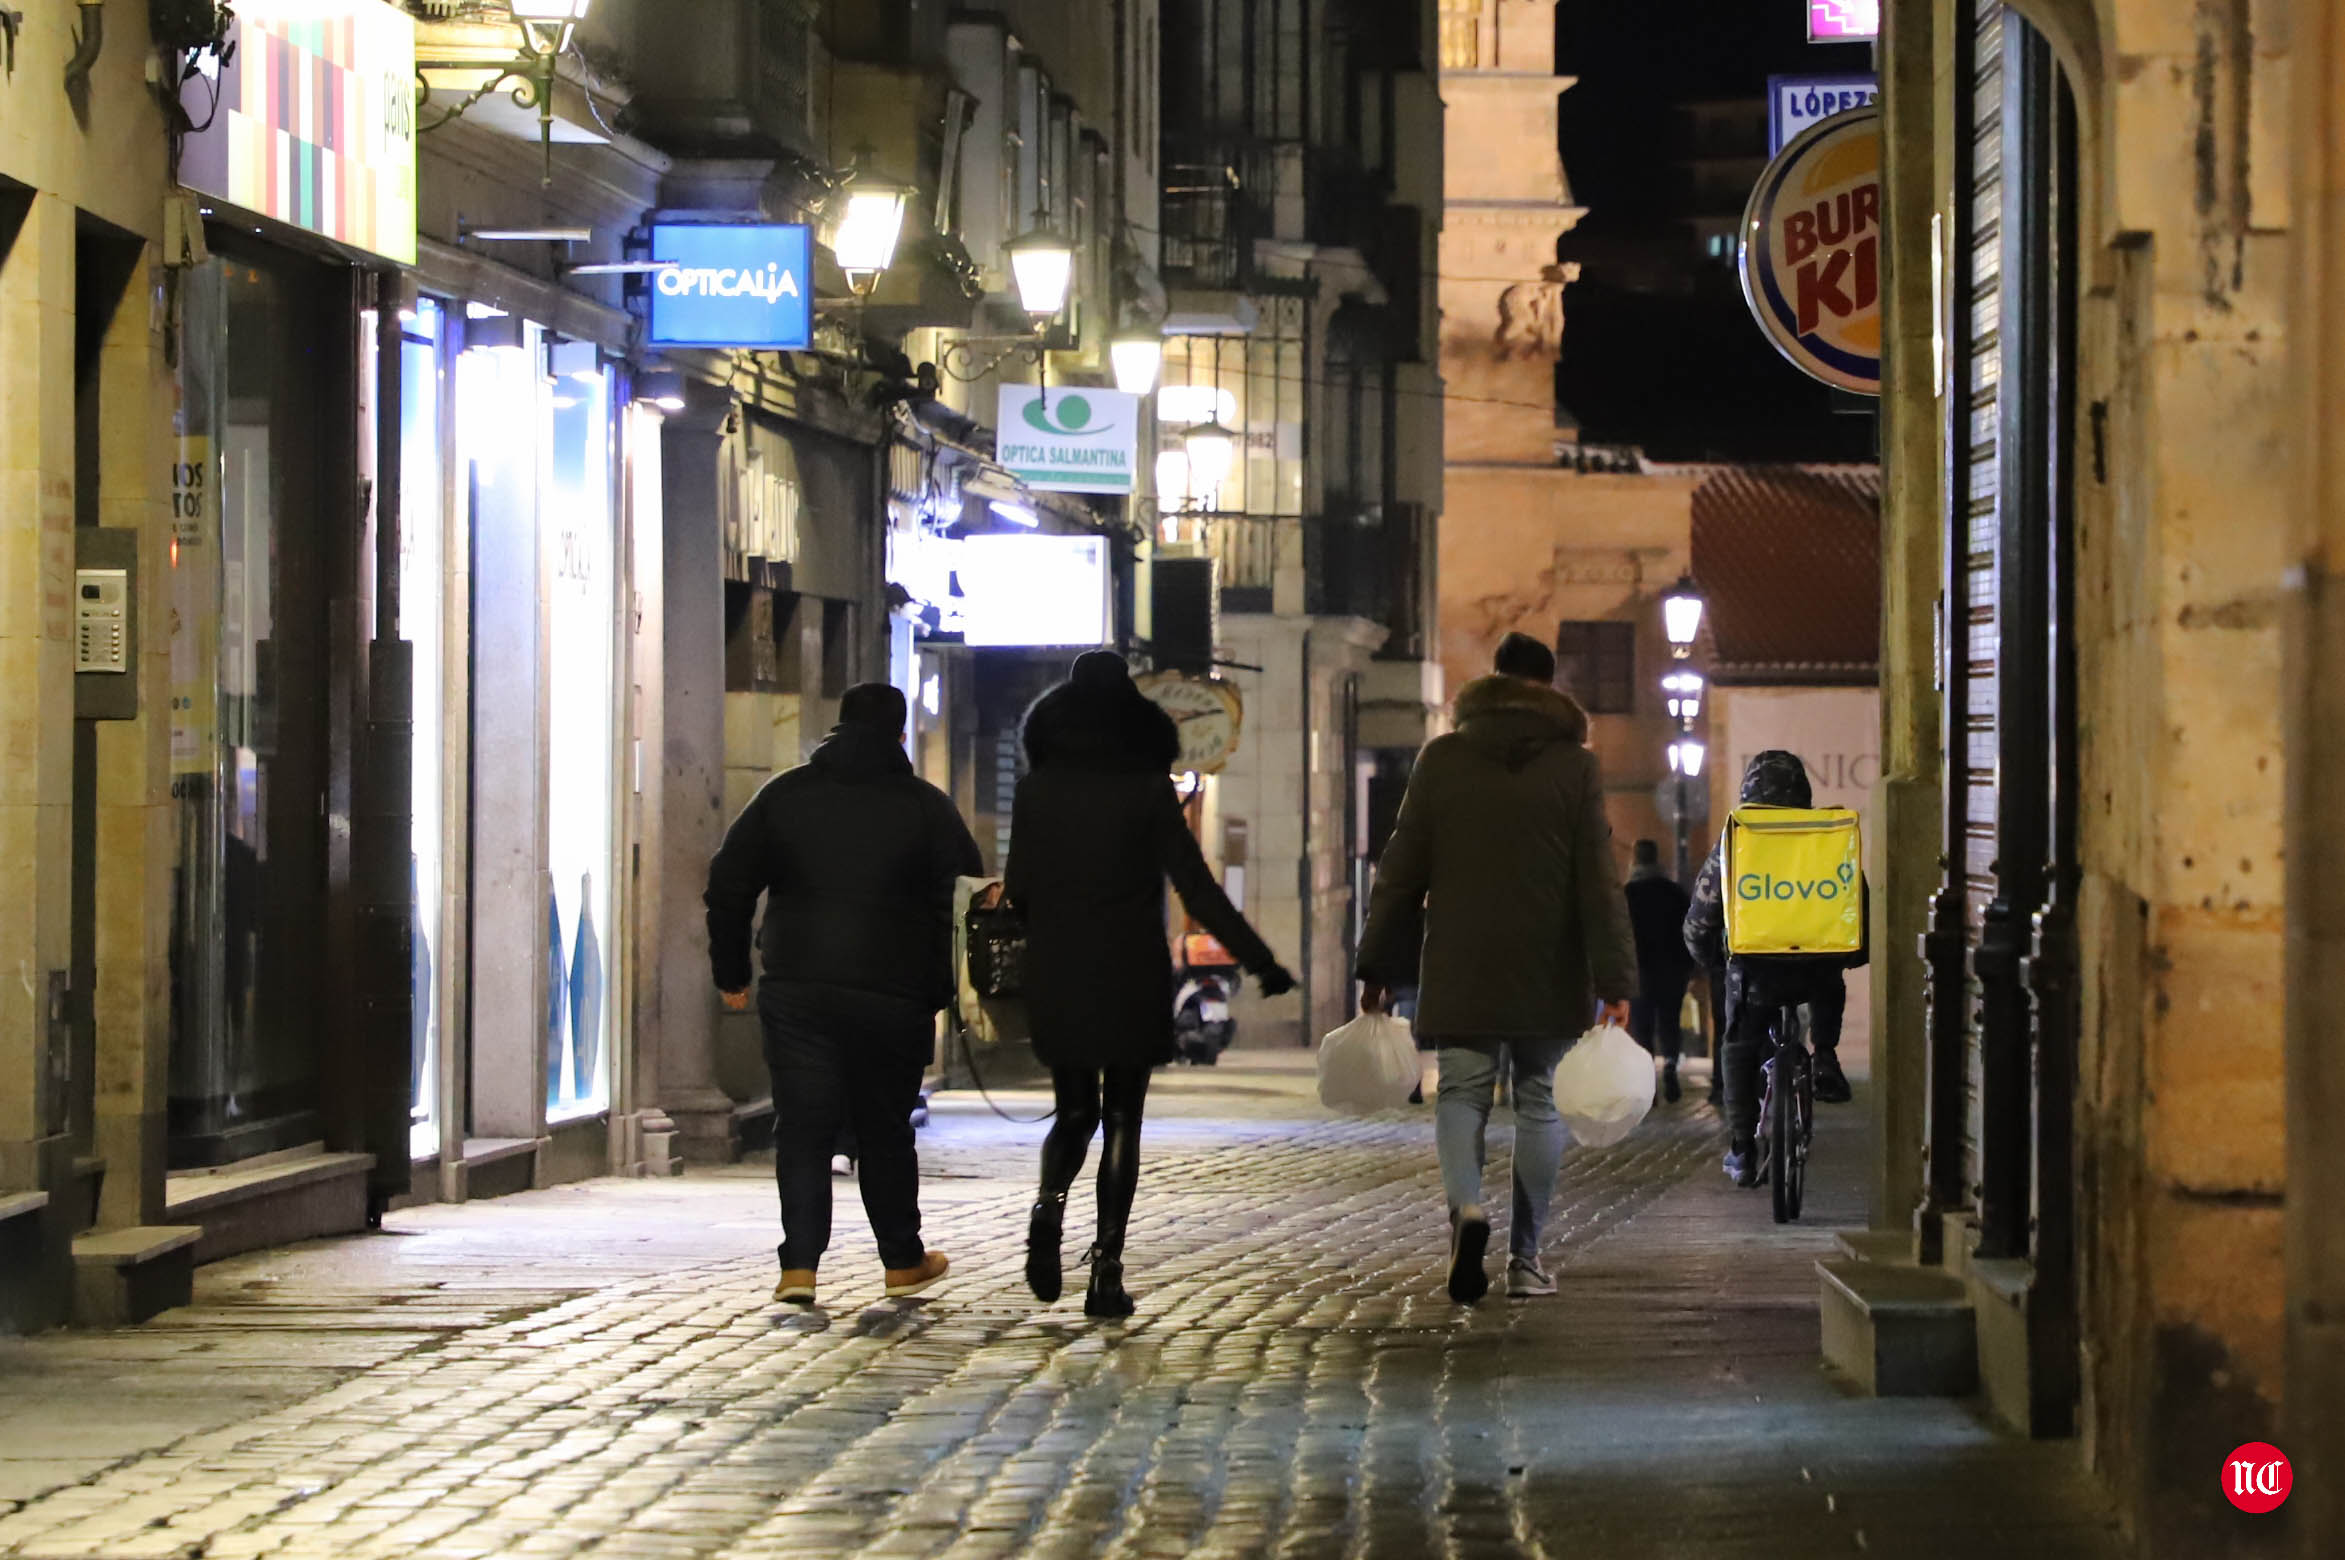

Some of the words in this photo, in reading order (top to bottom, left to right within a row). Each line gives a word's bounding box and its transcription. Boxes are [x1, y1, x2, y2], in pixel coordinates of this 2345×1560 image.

[1790, 87, 1866, 117] LÓPEZ
[1002, 445, 1046, 464] OPTICA
[1049, 448, 1127, 467] SALMANTINA
[1737, 873, 1838, 901] Glovo
